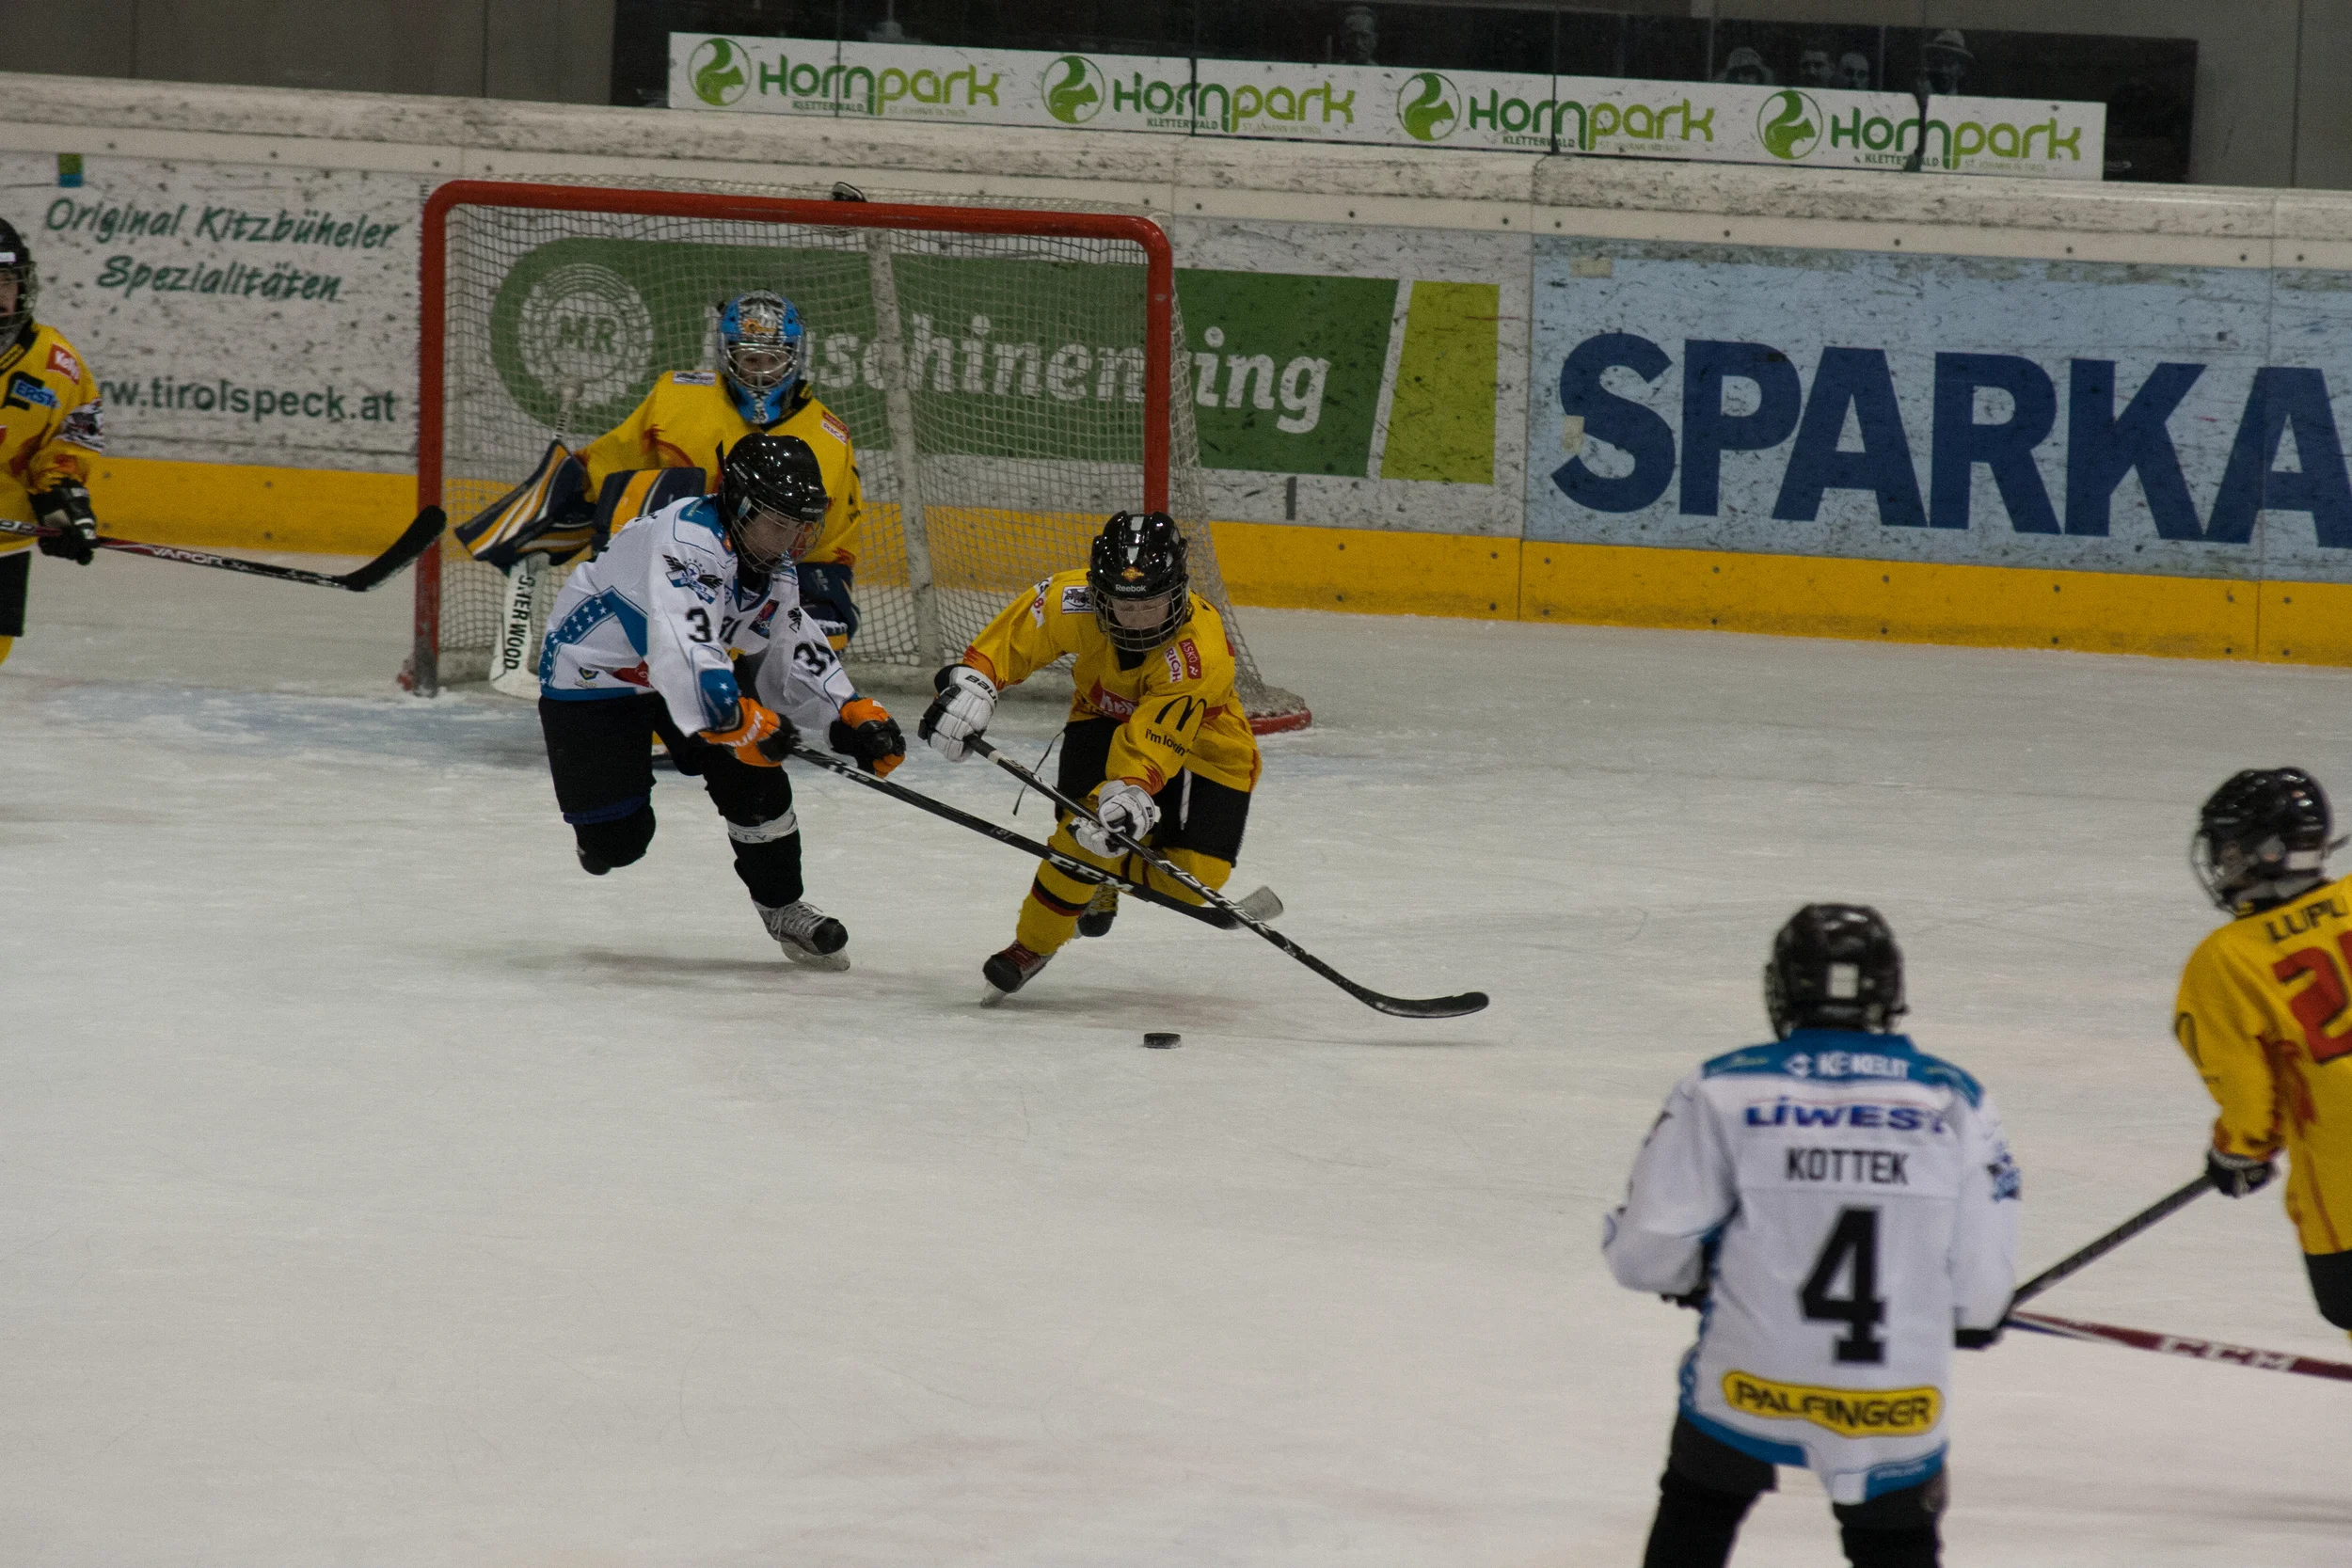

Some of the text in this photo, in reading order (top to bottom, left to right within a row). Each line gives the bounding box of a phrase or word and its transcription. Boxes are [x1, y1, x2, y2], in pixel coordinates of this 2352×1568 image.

[759, 54, 1000, 116] Hornpark
[1114, 71, 1355, 134] Hornpark
[1469, 88, 1714, 151] Hornpark
[1832, 106, 2082, 170] Hornpark
[46, 198, 402, 249] Original Kitzbüheler
[97, 255, 344, 302] Spezialitäten
[1550, 332, 2352, 548] SPARKA
[1115, 583, 1147, 593] Reebok
[2272, 927, 2352, 1064] 2
[1786, 1148, 1909, 1186] KOTTEK
[1798, 1205, 1886, 1366] 4
[1736, 1379, 1930, 1428] PALFINGER
